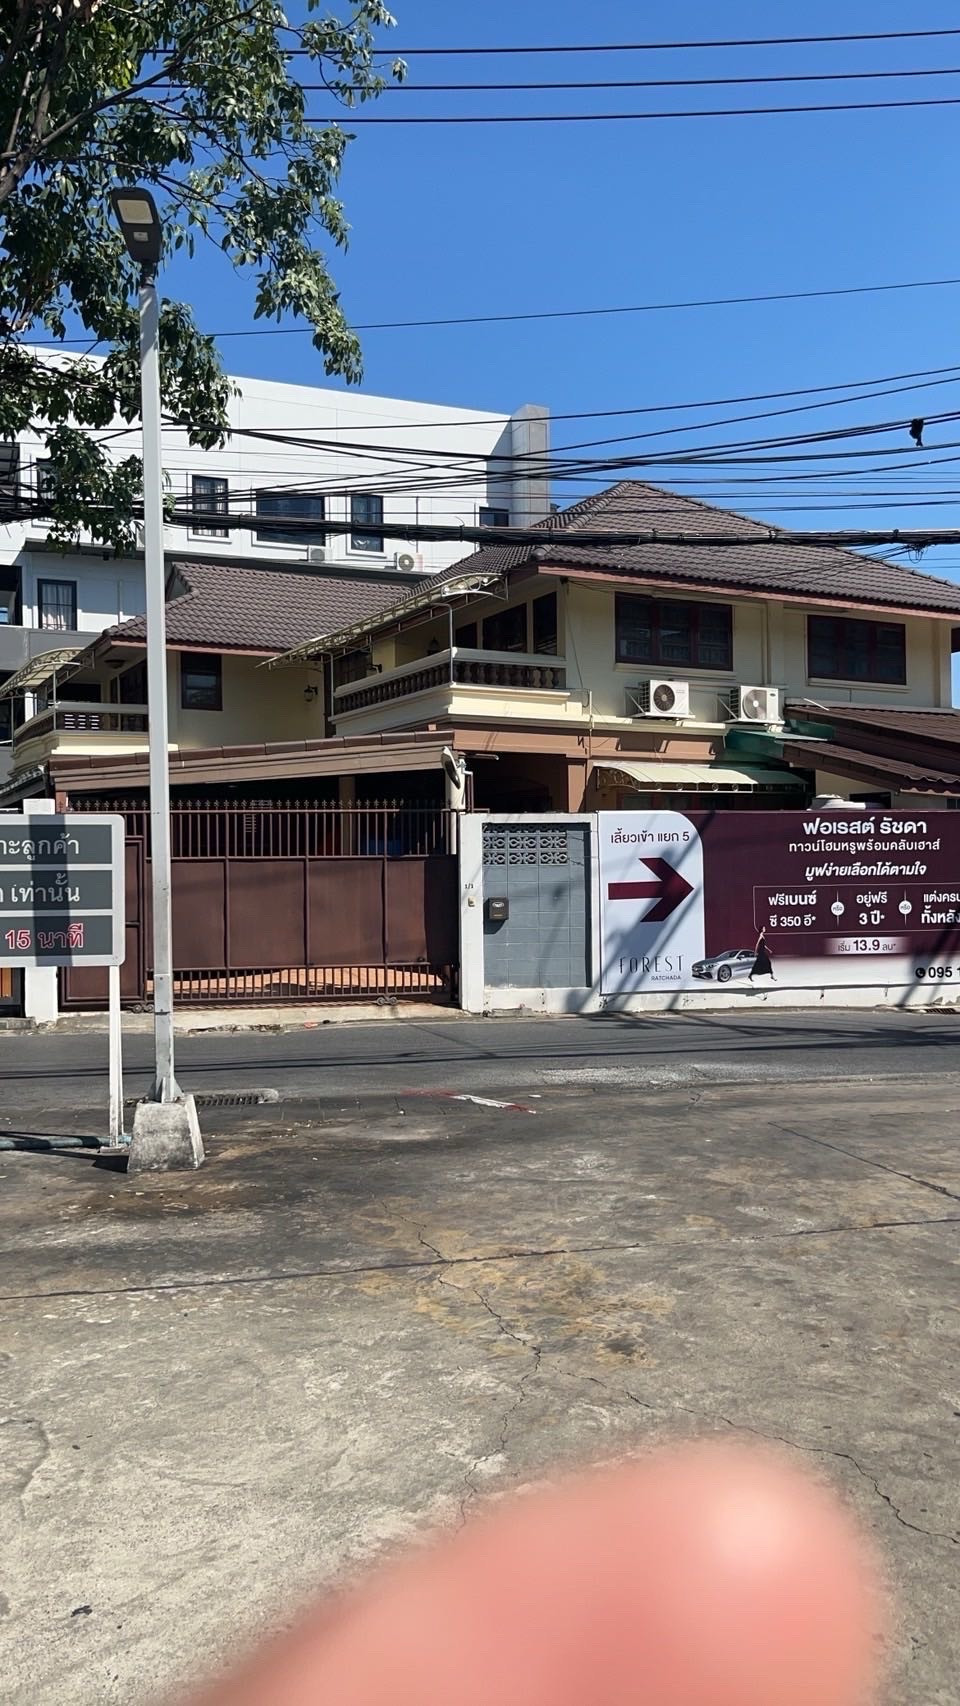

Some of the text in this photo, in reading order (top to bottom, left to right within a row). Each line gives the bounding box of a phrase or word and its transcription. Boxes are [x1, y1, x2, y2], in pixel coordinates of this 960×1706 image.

[802, 816, 927, 834] ฟอเรสต์ รัชดา
[610, 827, 690, 844] เลี้ยวเข้า แยก 5
[788, 838, 941, 855] ทาวน์โฮมหรูพร้อมคลับเฮาส์
[805, 861, 928, 881] มูฟง่ายเลือกได้ตามใจ
[11, 872, 80, 902] เท่านั้น
[768, 889, 817, 906] ฟรีเบนซ์
[856, 891, 888, 908] อยู่ฟรี
[780, 916, 801, 927] 350
[859, 913, 868, 925] 3
[5, 923, 84, 950] 15 นาที
[853, 939, 880, 951] 13.9
[618, 954, 684, 974] FOREST
[928, 966, 953, 978] 095
